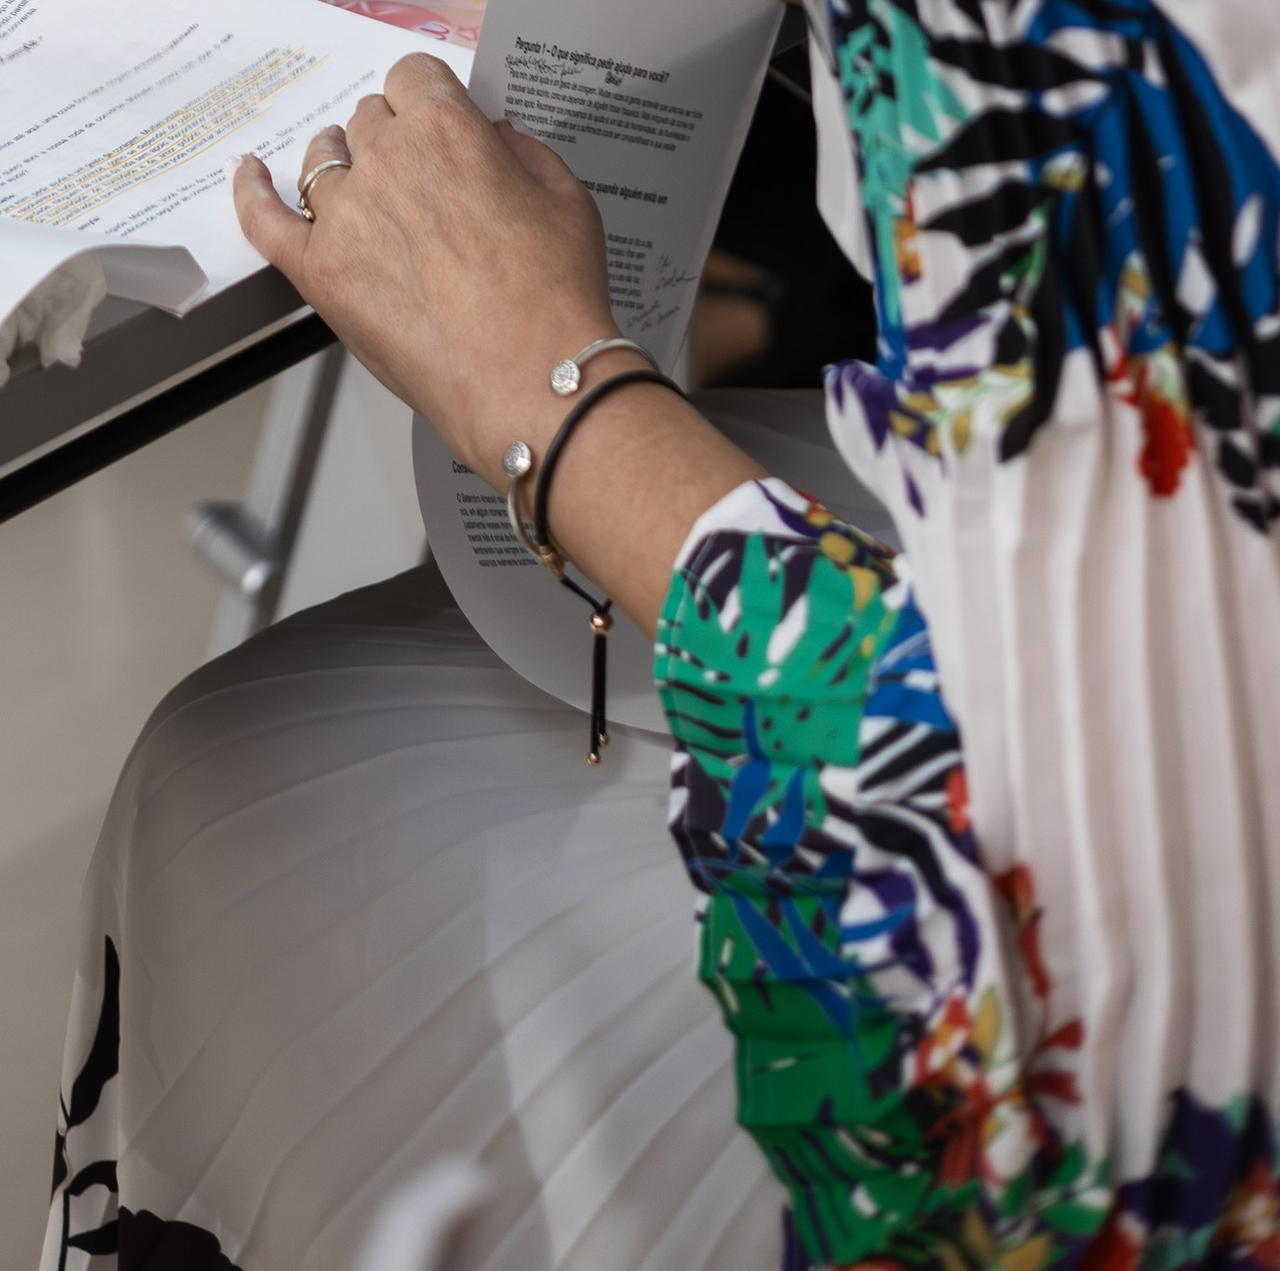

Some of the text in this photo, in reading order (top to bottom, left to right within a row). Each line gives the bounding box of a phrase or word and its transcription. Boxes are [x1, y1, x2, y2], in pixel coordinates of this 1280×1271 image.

[515, 36, 541, 54] Pergunta
[551, 45, 557, 57] O
[557, 49, 569, 60] que
[569, 50, 597, 65] significa
[596, 58, 614, 70] pedir
[632, 68, 648, 79] para
[648, 71, 670, 83] você?
[78, 217, 100, 230] amyla:
